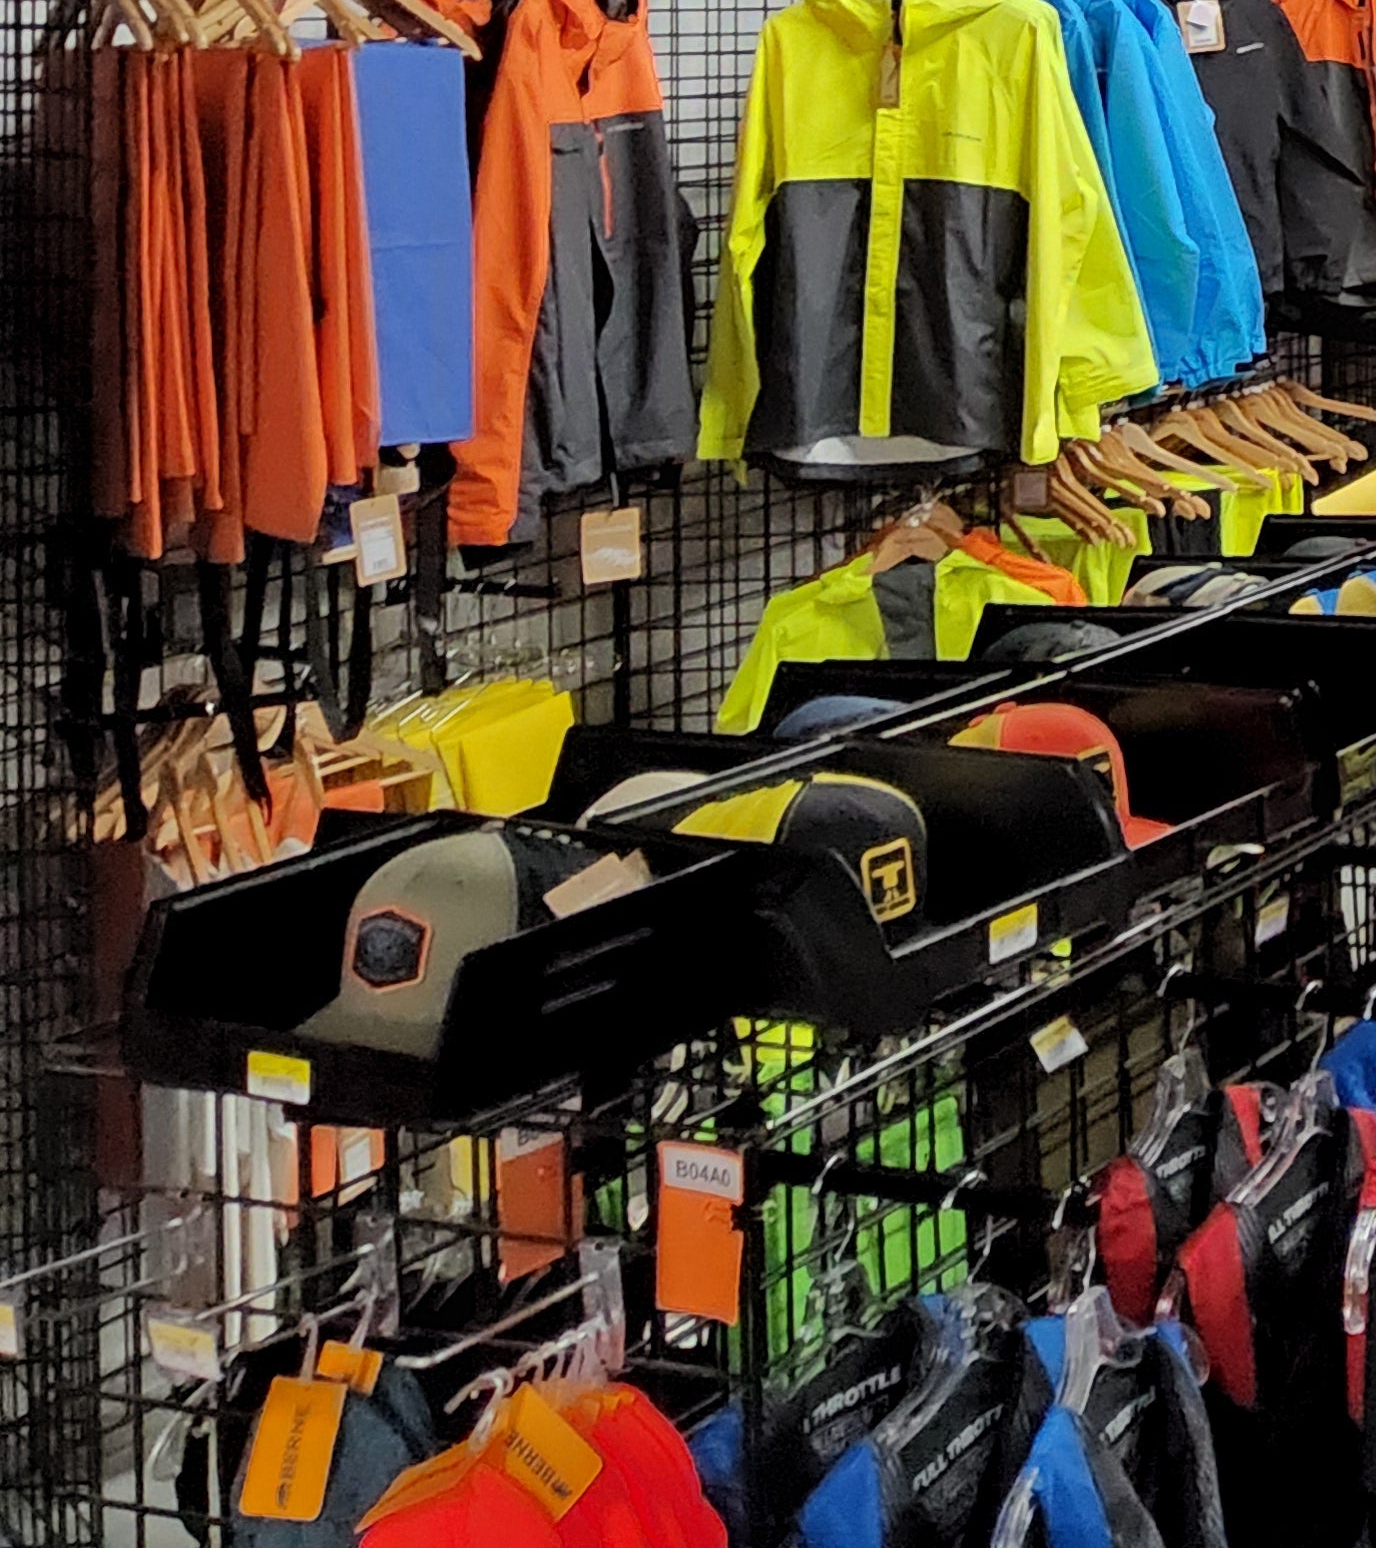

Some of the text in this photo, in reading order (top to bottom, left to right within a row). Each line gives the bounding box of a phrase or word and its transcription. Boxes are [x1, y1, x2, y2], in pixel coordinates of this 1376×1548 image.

[675, 1159, 732, 1188] B04A0
[811, 1363, 901, 1426] THROTTLE
[282, 1406, 311, 1471] BERNE
[502, 1427, 561, 1487] BERNE
